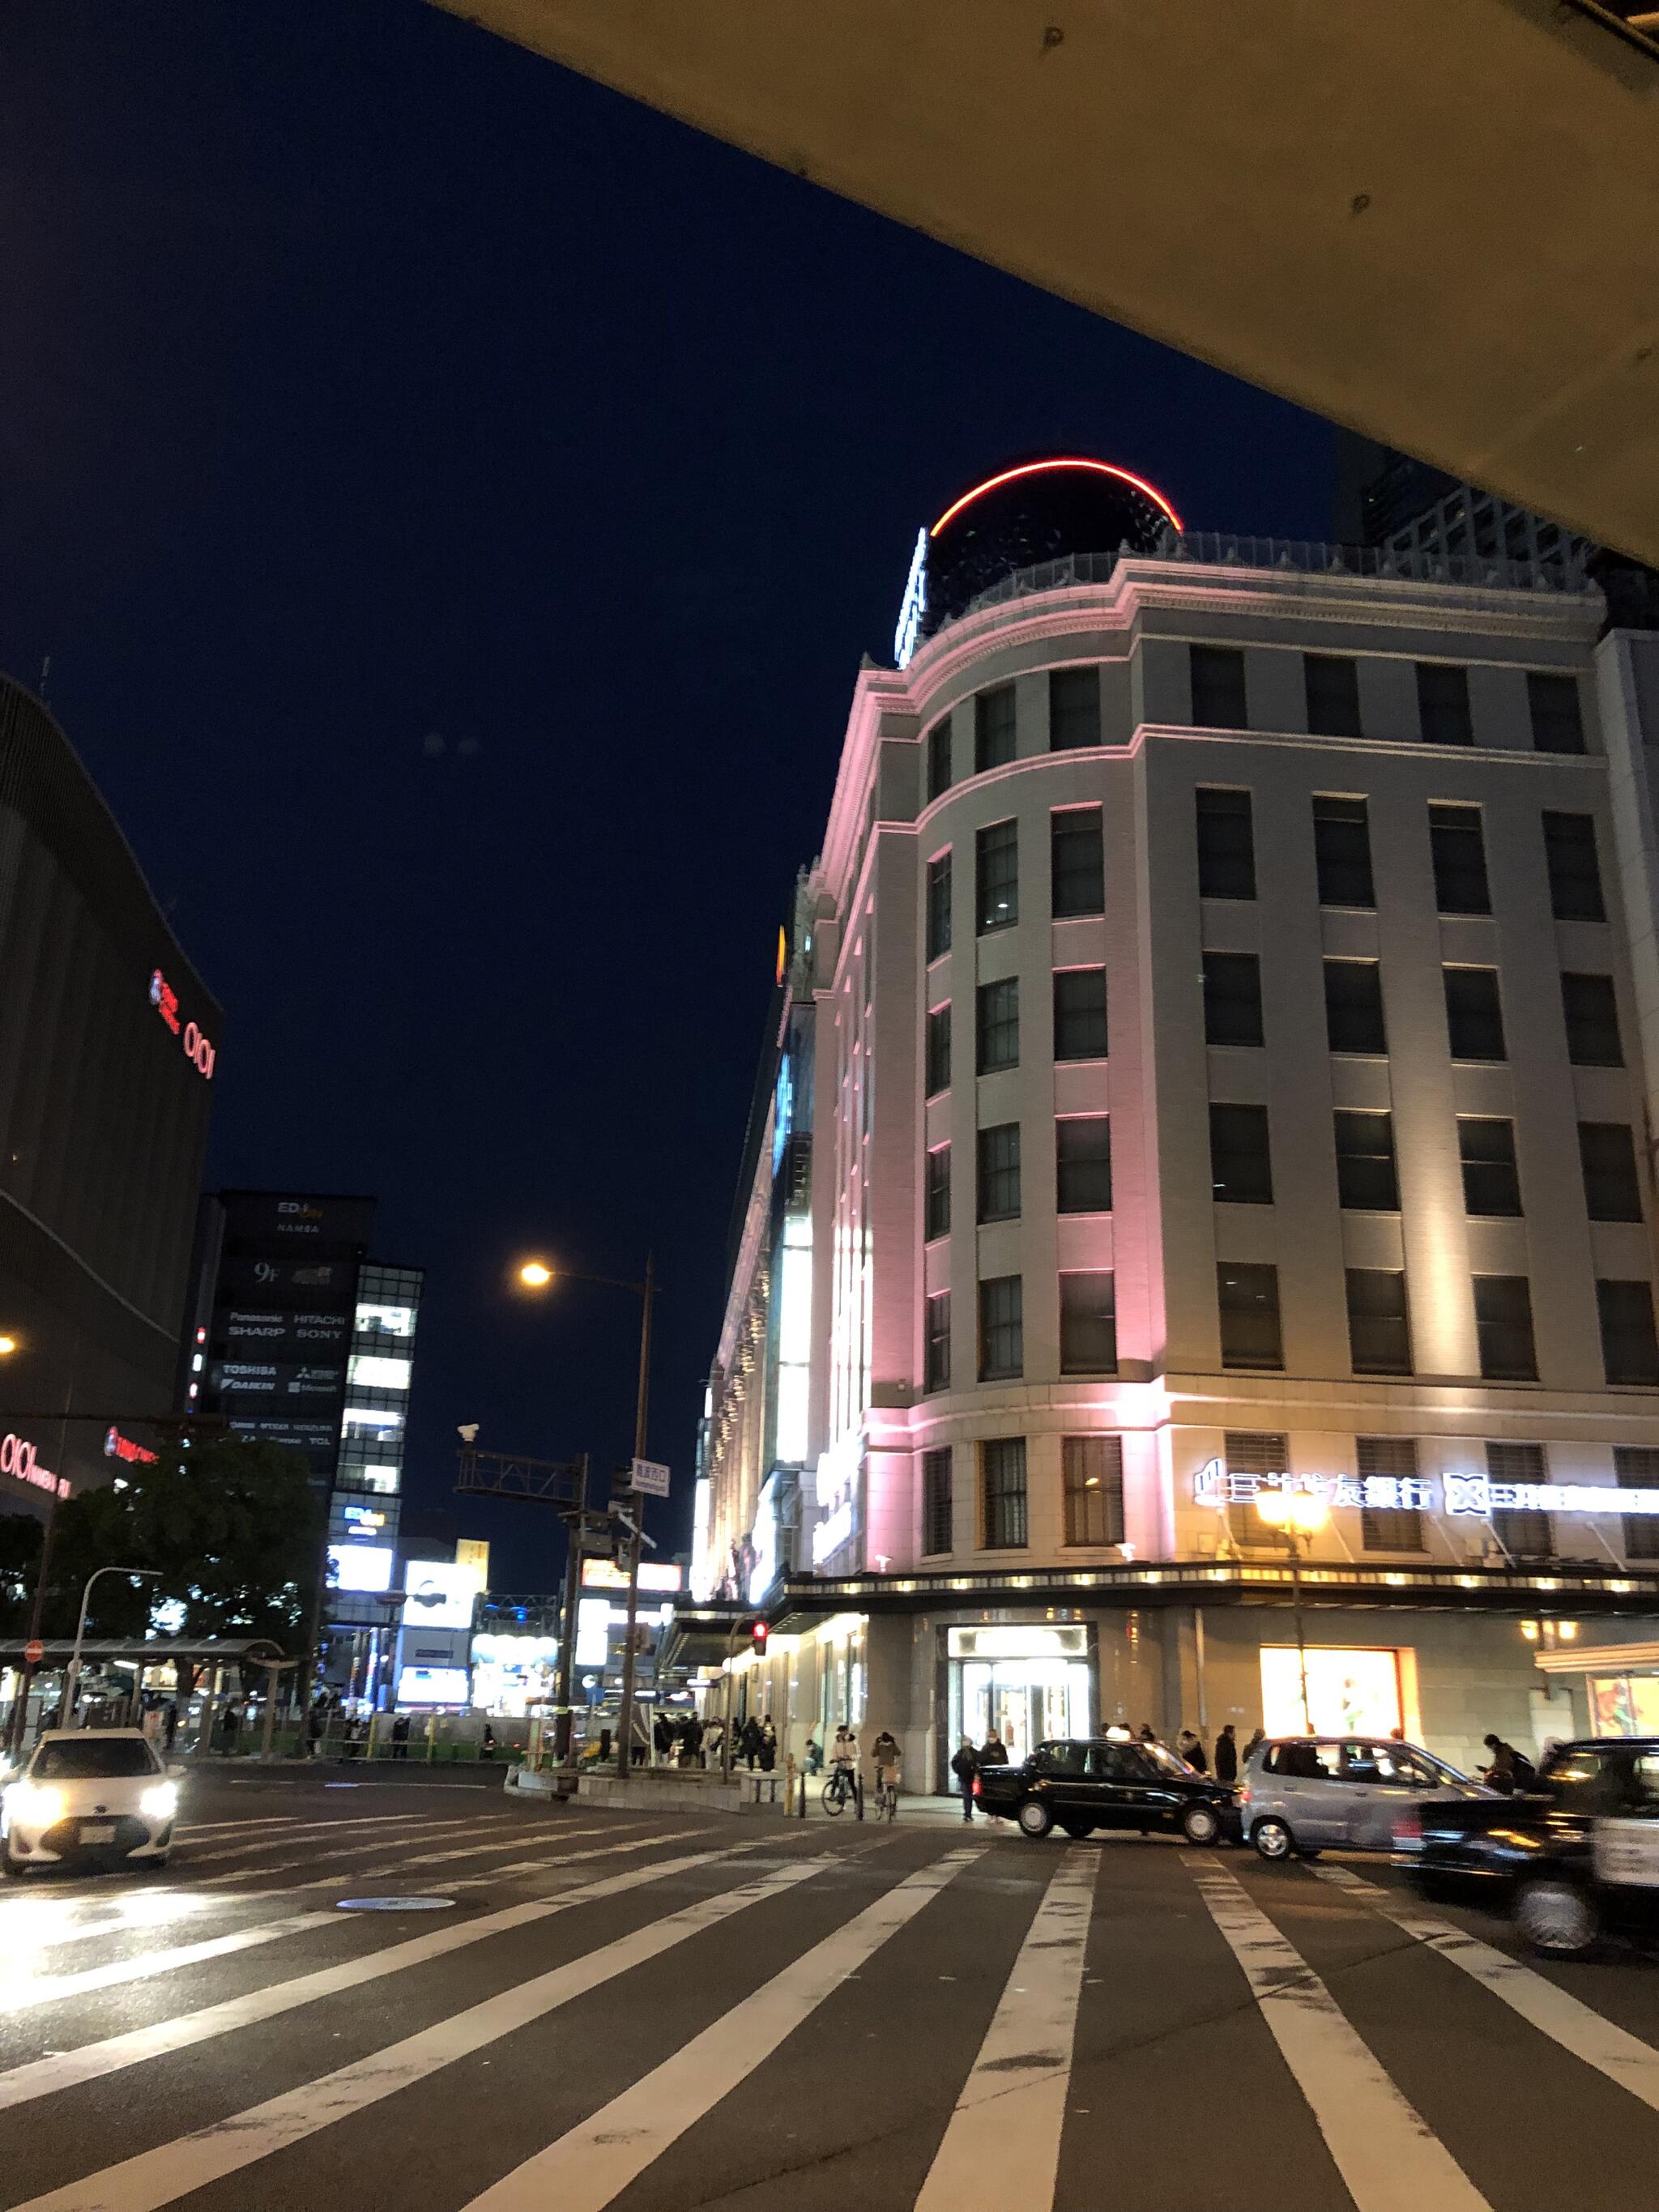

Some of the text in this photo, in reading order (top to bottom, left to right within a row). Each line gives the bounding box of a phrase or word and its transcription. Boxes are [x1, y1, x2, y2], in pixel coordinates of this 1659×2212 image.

[294, 1315, 345, 1325] HITACHI
[228, 1326, 285, 1336] SHARP
[296, 1328, 342, 1339] SONY
[223, 1365, 277, 1375] TOSHIBA
[231, 1381, 275, 1390] DAIKIN
[309, 1437, 331, 1446] TCL
